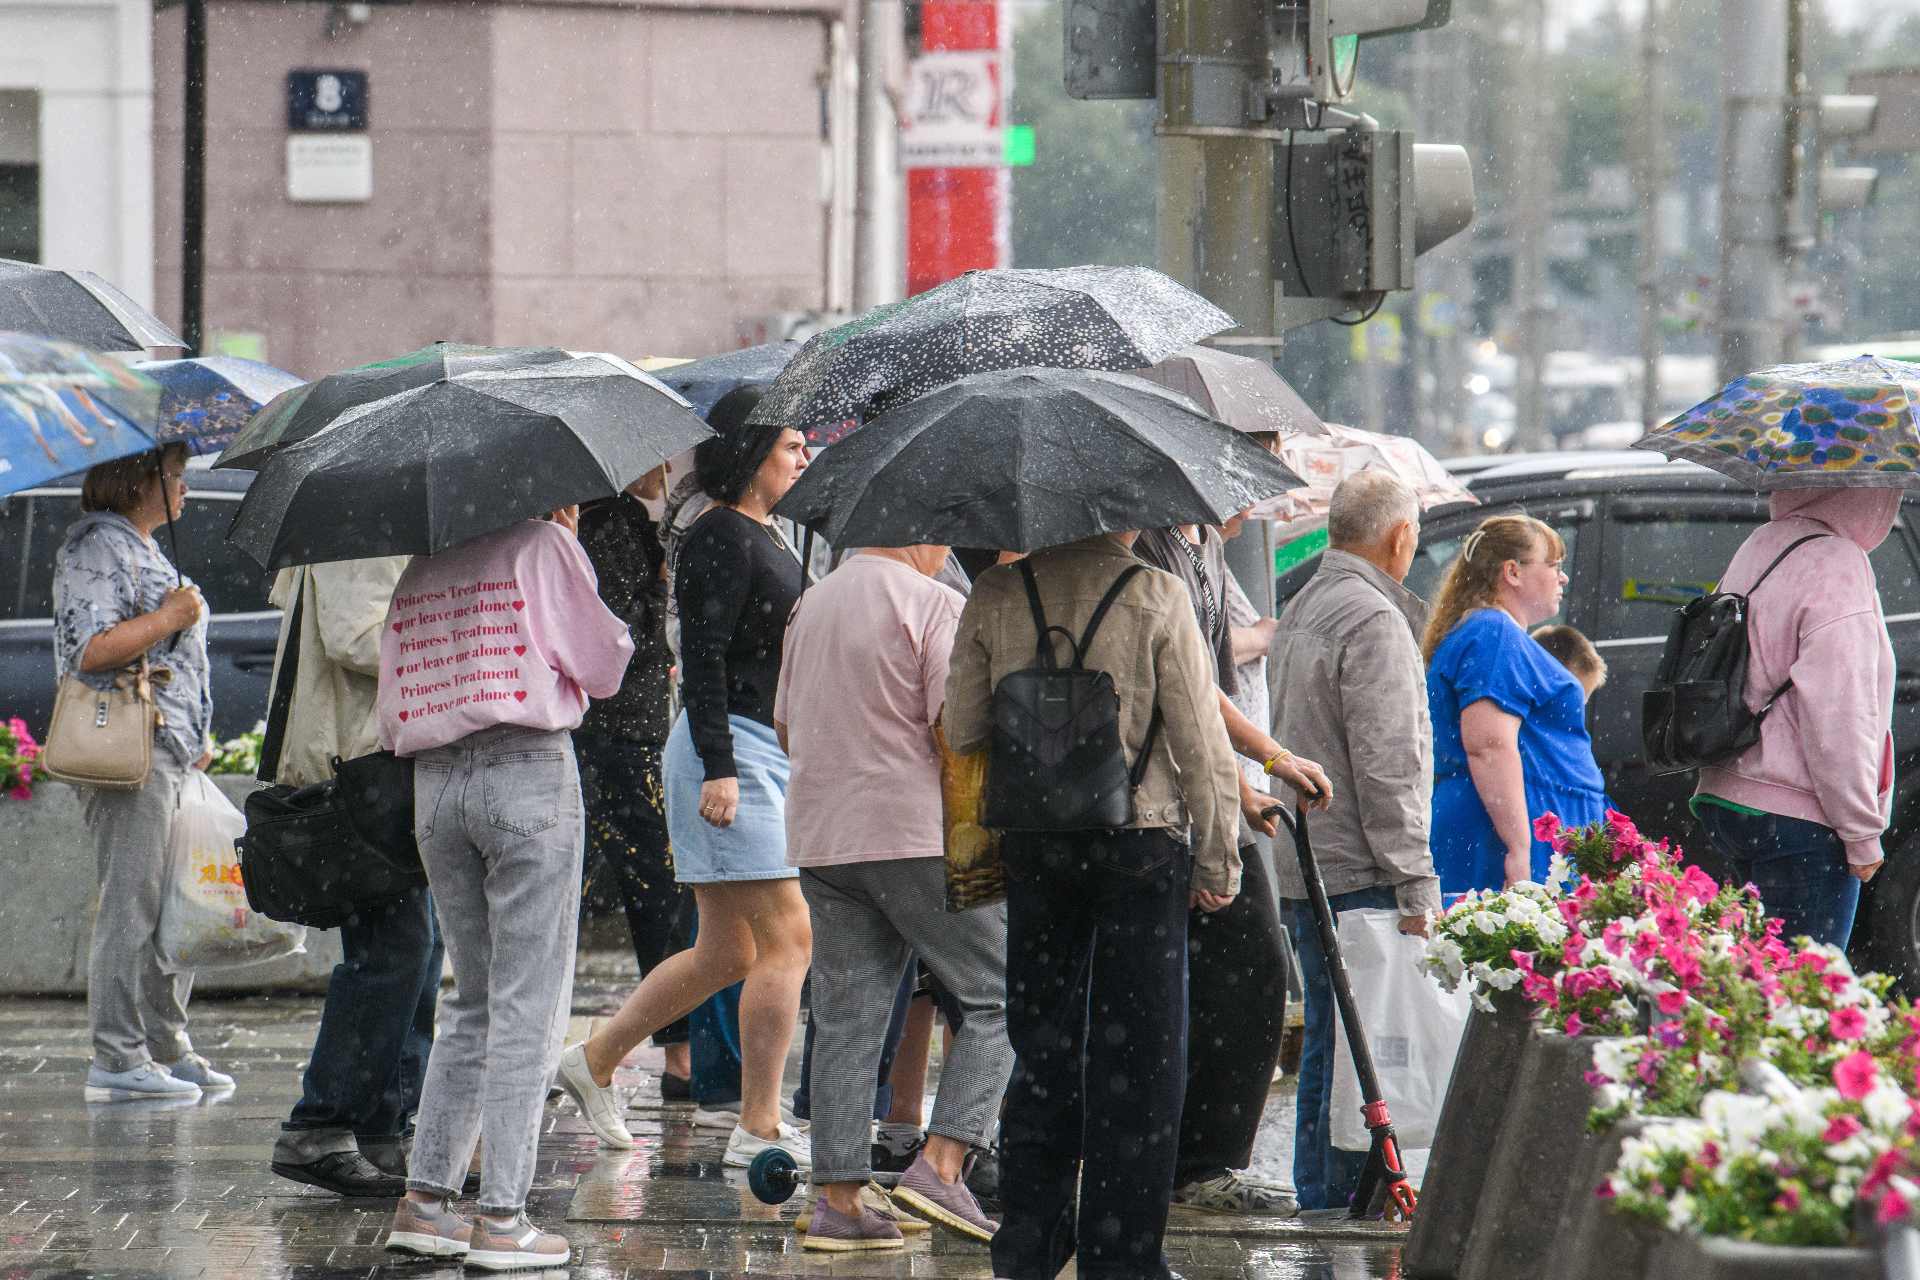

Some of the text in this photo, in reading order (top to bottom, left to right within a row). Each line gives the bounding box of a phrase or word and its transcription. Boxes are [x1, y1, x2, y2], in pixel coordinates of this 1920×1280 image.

[315, 74, 342, 112] 8
[1169, 526, 1206, 577] UNAFFEC
[396, 579, 518, 611] Princess Treatment
[404, 599, 510, 629] or leave me alone
[400, 622, 518, 656] Princess Treatment
[406, 643, 511, 675] or leave me alone
[400, 667, 520, 700] Princess Treatment
[411, 688, 511, 720] or leave me alone
